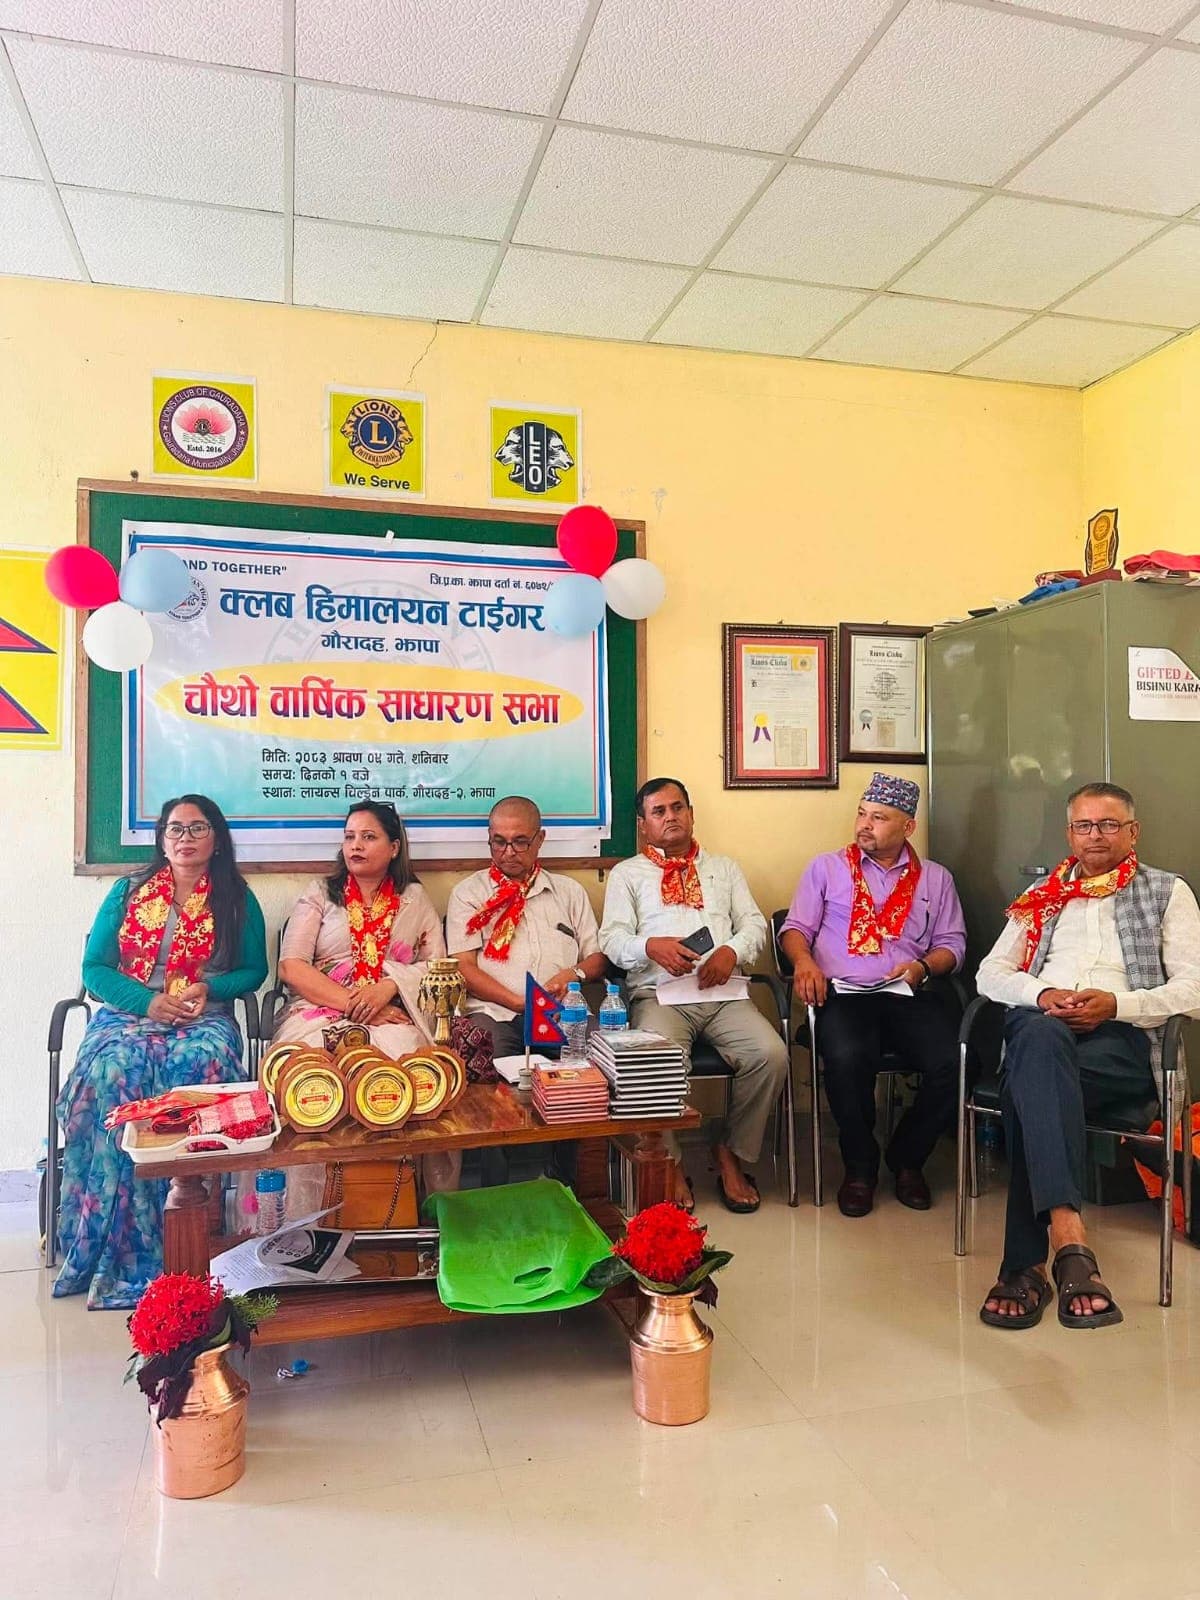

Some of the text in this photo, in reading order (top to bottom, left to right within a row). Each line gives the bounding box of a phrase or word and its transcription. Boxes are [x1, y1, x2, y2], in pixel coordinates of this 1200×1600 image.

[162, 400, 177, 422] LIONS
[175, 388, 195, 404] CLUB
[196, 388, 208, 396] OF
[356, 402, 398, 419] LIONS
[370, 420, 387, 444] L
[356, 448, 398, 463] INTERNATIONAL
[528, 426, 542, 484] LEO
[344, 472, 410, 490] We Serve
[212, 562, 287, 575] TOGETHER"
[468, 578, 492, 588] झापा
[494, 578, 510, 589] दर्ता
[220, 584, 545, 633] क्लब हिमालयन टाईगर
[394, 638, 440, 653] झापा
[1137, 666, 1181, 680] GIFTED
[1136, 681, 1172, 691] BISHNU
[184, 672, 560, 725] चौथो वार्षिक साधारण सभा
[295, 752, 327, 765] २०८३
[333, 752, 362, 763] श्रावण
[300, 766, 336, 781] दिनको
[340, 770, 347, 780] १
[300, 787, 341, 798] लायन्स
[345, 784, 380, 800] चिल्ड्रेन
[470, 787, 496, 798] झापा
